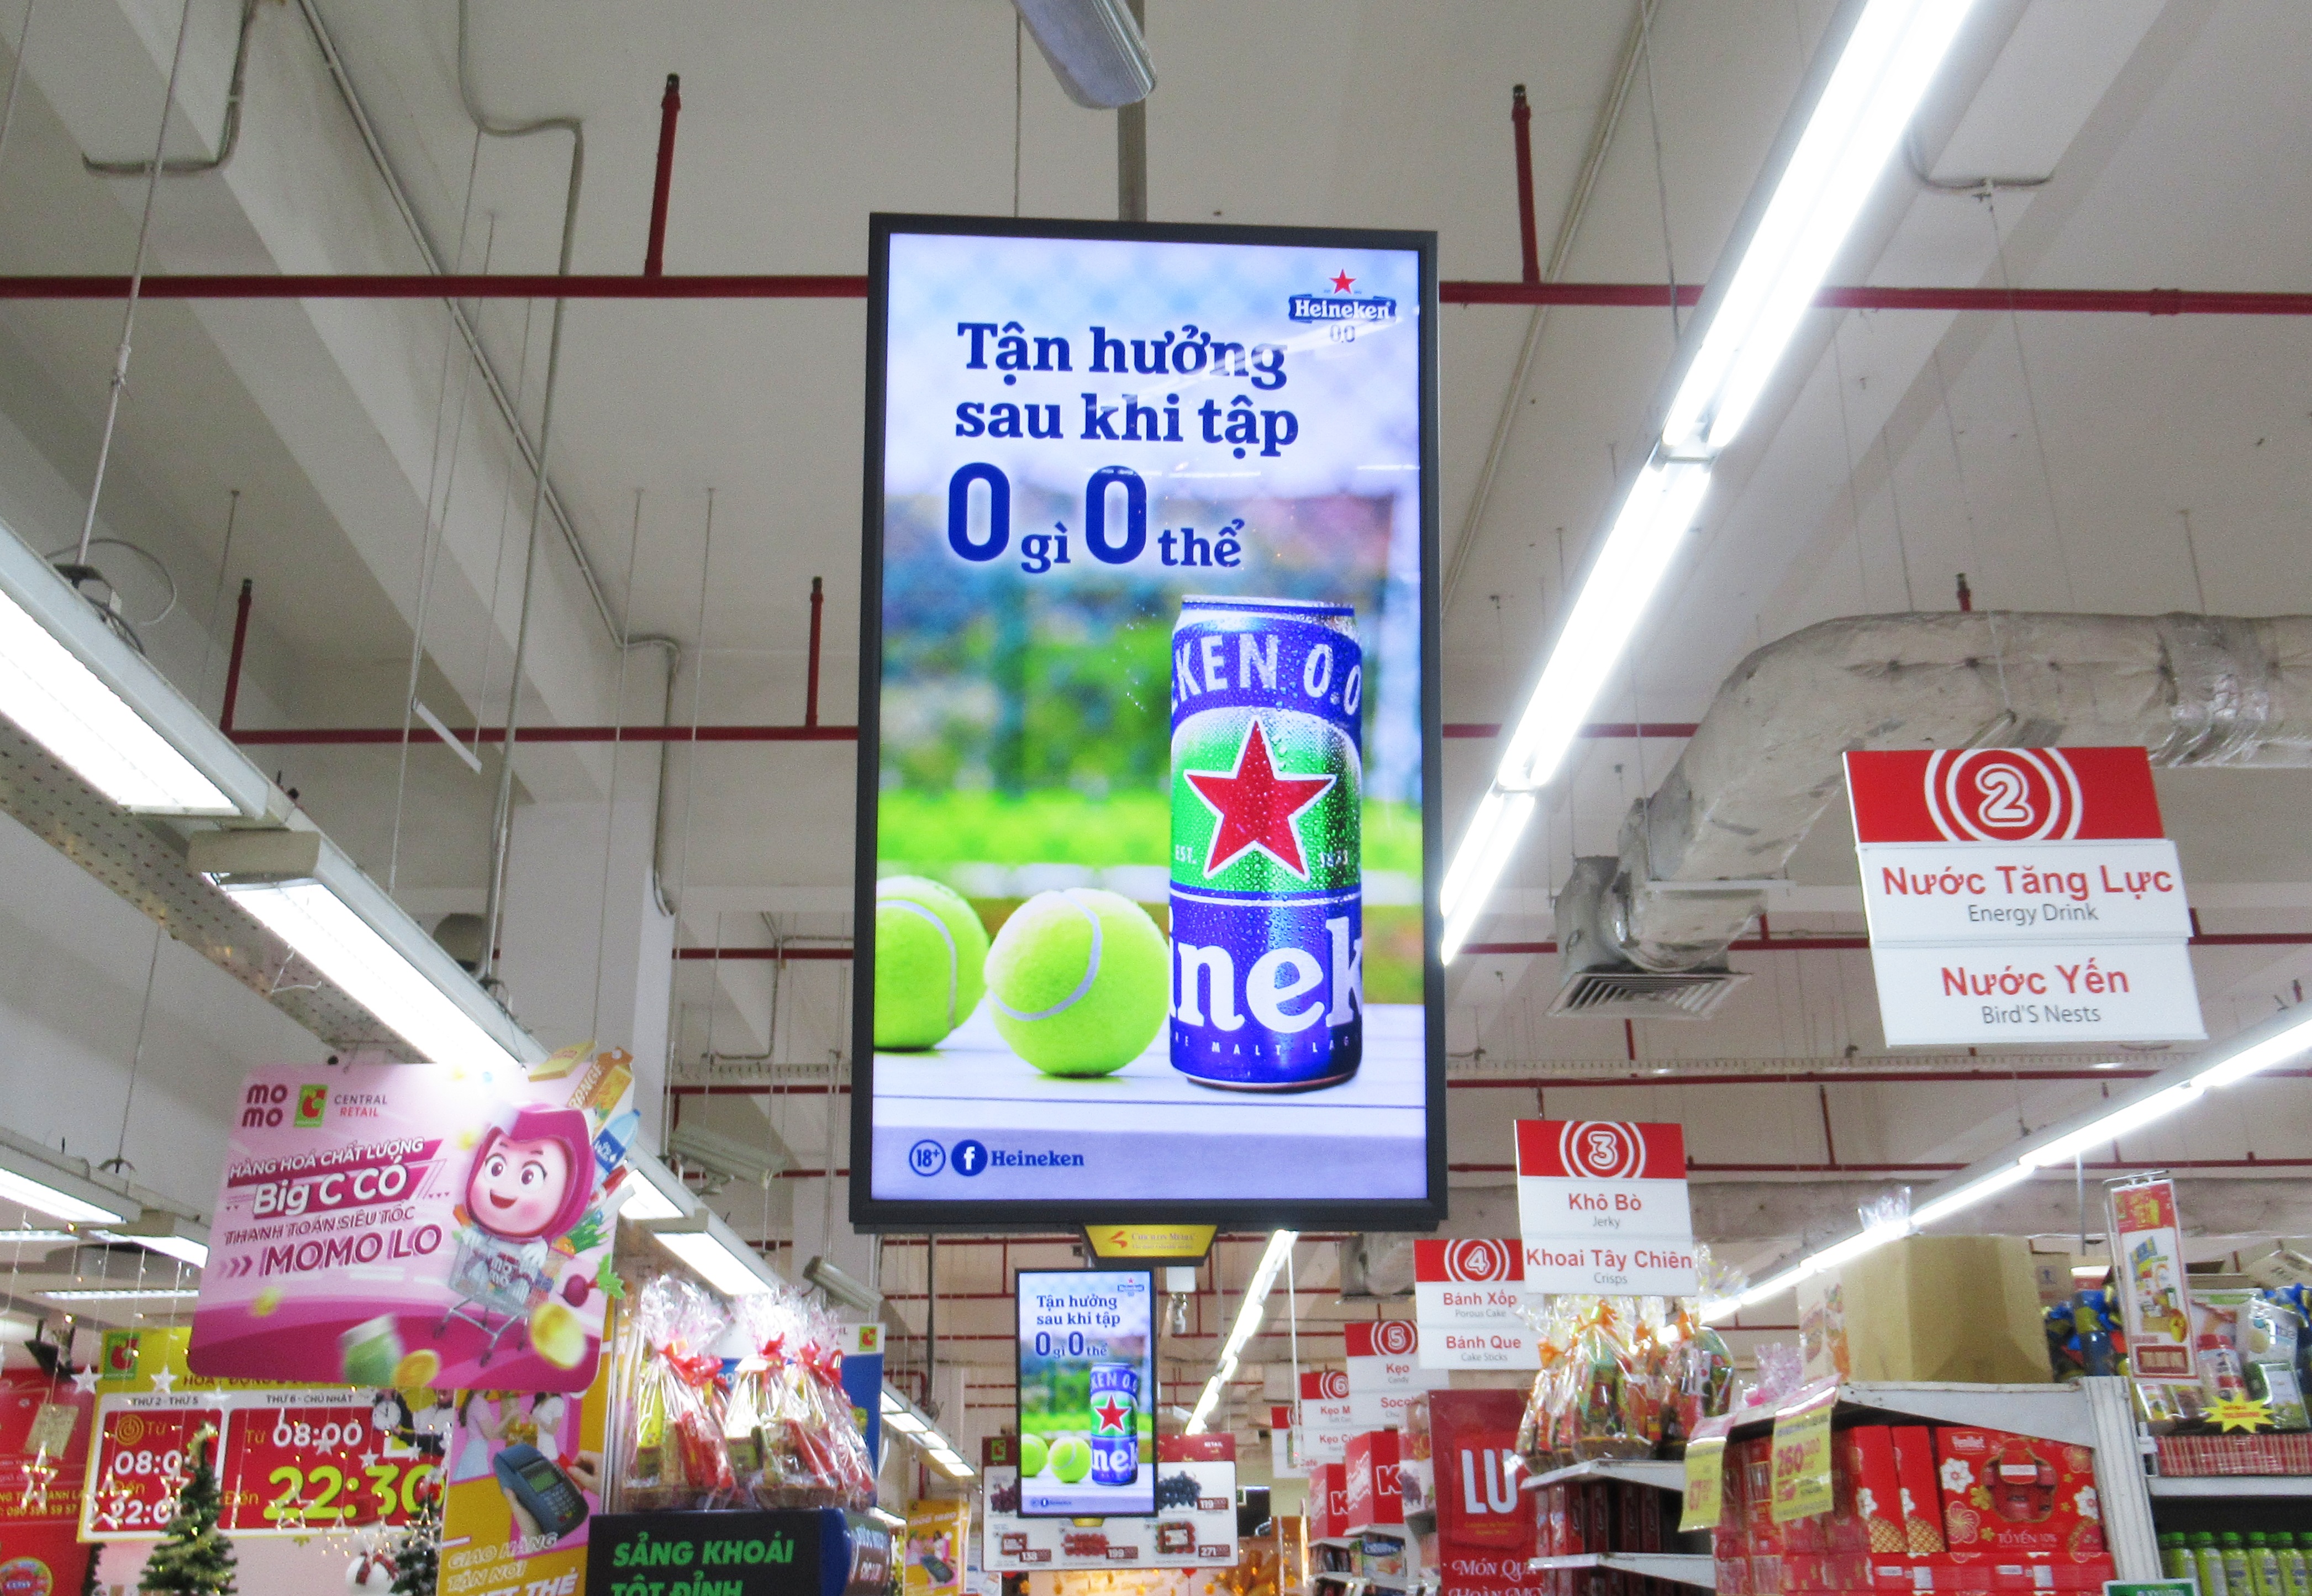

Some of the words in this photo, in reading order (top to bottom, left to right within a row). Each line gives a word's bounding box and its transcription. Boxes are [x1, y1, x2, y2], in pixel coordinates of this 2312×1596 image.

[1295, 299, 1390, 319] Heineken
[957, 322, 1072, 385] Tận
[1089, 324, 1287, 391] hưởng
[955, 402, 1063, 438] sau
[1080, 393, 1183, 442] khi
[1198, 394, 1298, 458] tập
[947, 462, 1011, 562] 0
[1020, 522, 1071, 573] gì
[1084, 465, 1147, 563] 0
[1158, 518, 1245, 568] thể
[1172, 633, 1279, 716] KEN
[1976, 763, 2035, 827] 2
[1882, 866, 1986, 895] Nước
[1995, 866, 2089, 901] Tăng
[2099, 865, 2173, 900] Lực
[1968, 904, 2037, 926] Energy
[2042, 904, 2099, 921] Drink
[1941, 966, 2046, 996] Nước
[2055, 957, 2130, 994] Yến
[1982, 1005, 2039, 1024] Bird'S
[2045, 1004, 2101, 1023] Nests
[1212, 1042, 1281, 1056] MALT
[247, 1084, 288, 1104] mo
[334, 1094, 387, 1105] CENTRAL
[241, 1107, 283, 1127] mo
[340, 1107, 379, 1116] RETAIL
[230, 1157, 276, 1178] HÀNG
[281, 1150, 315, 1171] HOÁ
[320, 1140, 363, 1166] CHẤT
[367, 1137, 424, 1160] LƯỢNG
[917, 1149, 940, 1167] 18+
[991, 1150, 1085, 1167] Heineken
[1588, 1130, 1618, 1170] 3
[254, 1179, 310, 1215] Big
[319, 1173, 346, 1204] C
[354, 1156, 408, 1200] CÓ
[1568, 1193, 1608, 1211] Khô
[1615, 1193, 1642, 1211] Bò
[225, 1226, 282, 1245] THANH
[287, 1216, 338, 1237] TOÁN
[339, 1208, 377, 1228] SIÊU
[380, 1199, 415, 1223] TỐC
[1593, 1216, 1620, 1228] Jerky
[262, 1231, 383, 1276] MOMO
[390, 1224, 443, 1259] LO
[1465, 1246, 1491, 1275] 4
[1526, 1249, 1585, 1266] Khoai
[1591, 1249, 1628, 1272] Tây
[1634, 1250, 1693, 1268] Chiên
[1594, 1272, 1628, 1286] Crisps
[1036, 1295, 1064, 1311] Tận
[1069, 1294, 1117, 1309] hưởng
[1443, 1292, 1482, 1305] Bánh
[1487, 1289, 1518, 1308] Xốp
[1037, 1315, 1062, 1324] sau
[1067, 1312, 1091, 1324] khi
[1096, 1312, 1120, 1328] tập
[1455, 1309, 1484, 1318] Porous
[1486, 1309, 1507, 1318] Cake
[1035, 1331, 1050, 1356] 0
[1054, 1347, 1065, 1359] gì
[1068, 1331, 1084, 1356] 0
[1388, 1326, 1406, 1350] 5
[1446, 1335, 1486, 1349] Bánh
[1490, 1335, 1521, 1349] Que
[1461, 1353, 1482, 1361] Cake
[1484, 1353, 1508, 1361] Sticks
[1386, 1363, 1410, 1376] Kẹo
[1333, 1374, 1349, 1394] 6
[1321, 1405, 1339, 1415] Kẹo
[273, 1422, 363, 1447] 08:00
[1319, 1434, 1339, 1444] Kẹo
[114, 1449, 191, 1475] 08:0
[1461, 1448, 1518, 1513] LU
[263, 1464, 445, 1520] 22:30
[109, 1499, 181, 1525] 22:0
[448, 1545, 496, 1568] GIAO
[613, 1531, 694, 1567] SẢNG
